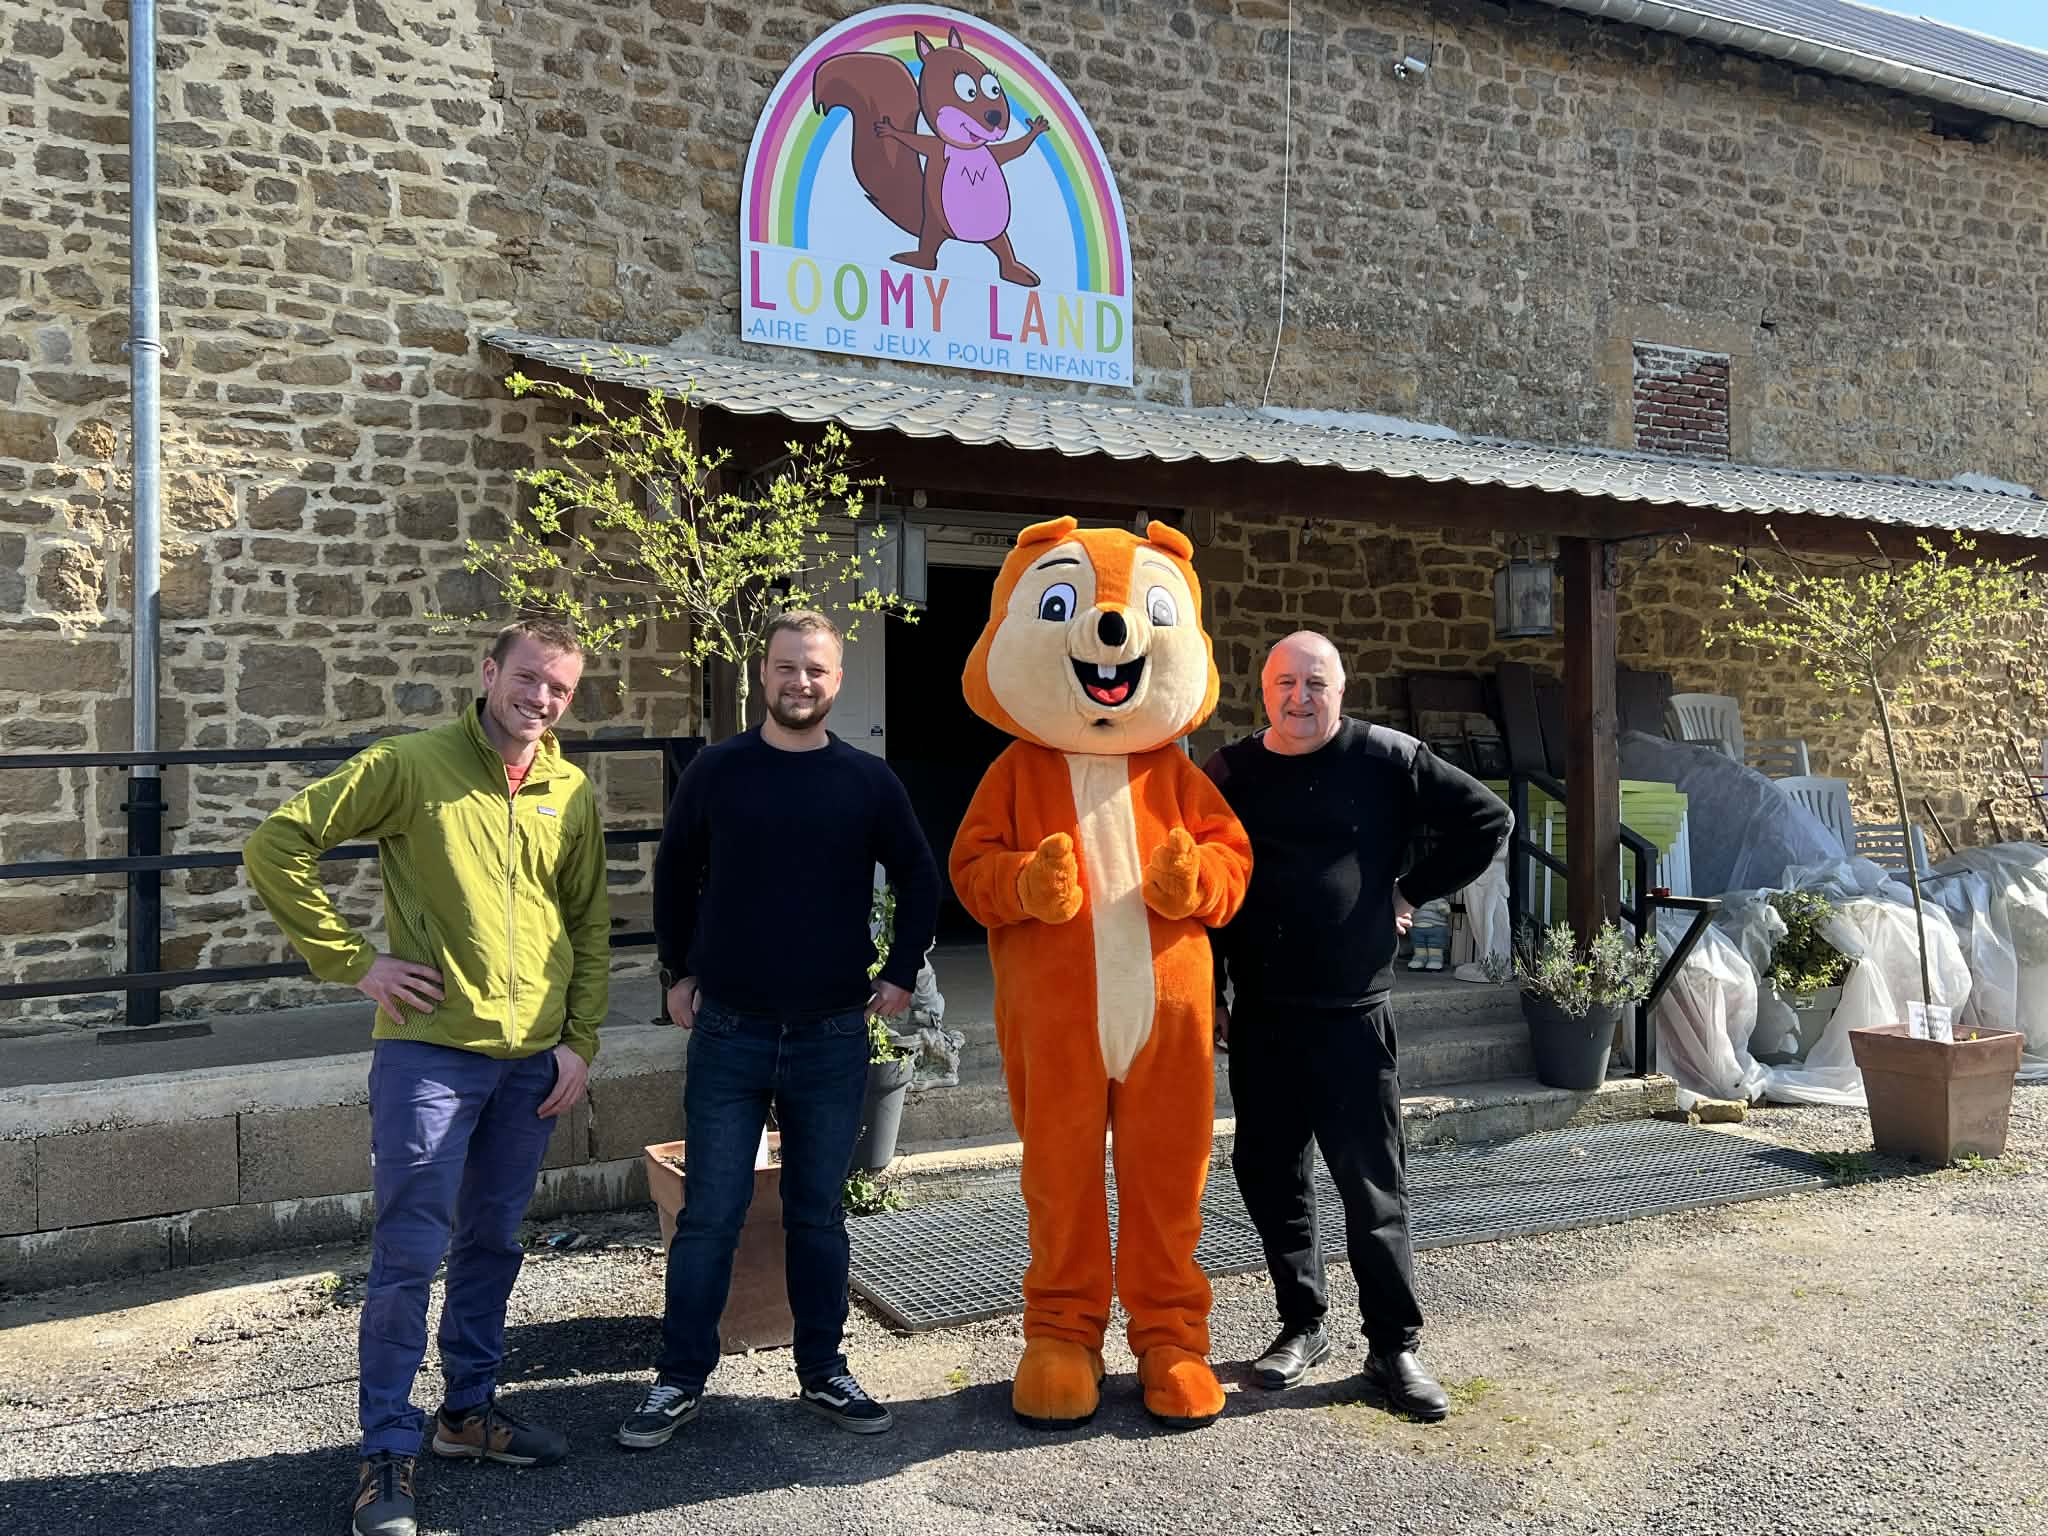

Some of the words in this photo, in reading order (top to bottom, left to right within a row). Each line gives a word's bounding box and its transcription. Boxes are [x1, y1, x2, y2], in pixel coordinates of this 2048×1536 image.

[750, 250, 949, 332] LOOMY
[989, 285, 1124, 353] LAND
[751, 318, 808, 342] AIRE
[826, 327, 857, 349] DE
[873, 335, 931, 358] JEUX
[948, 343, 1010, 366] POUR
[1026, 353, 1121, 380] ENFANTS
